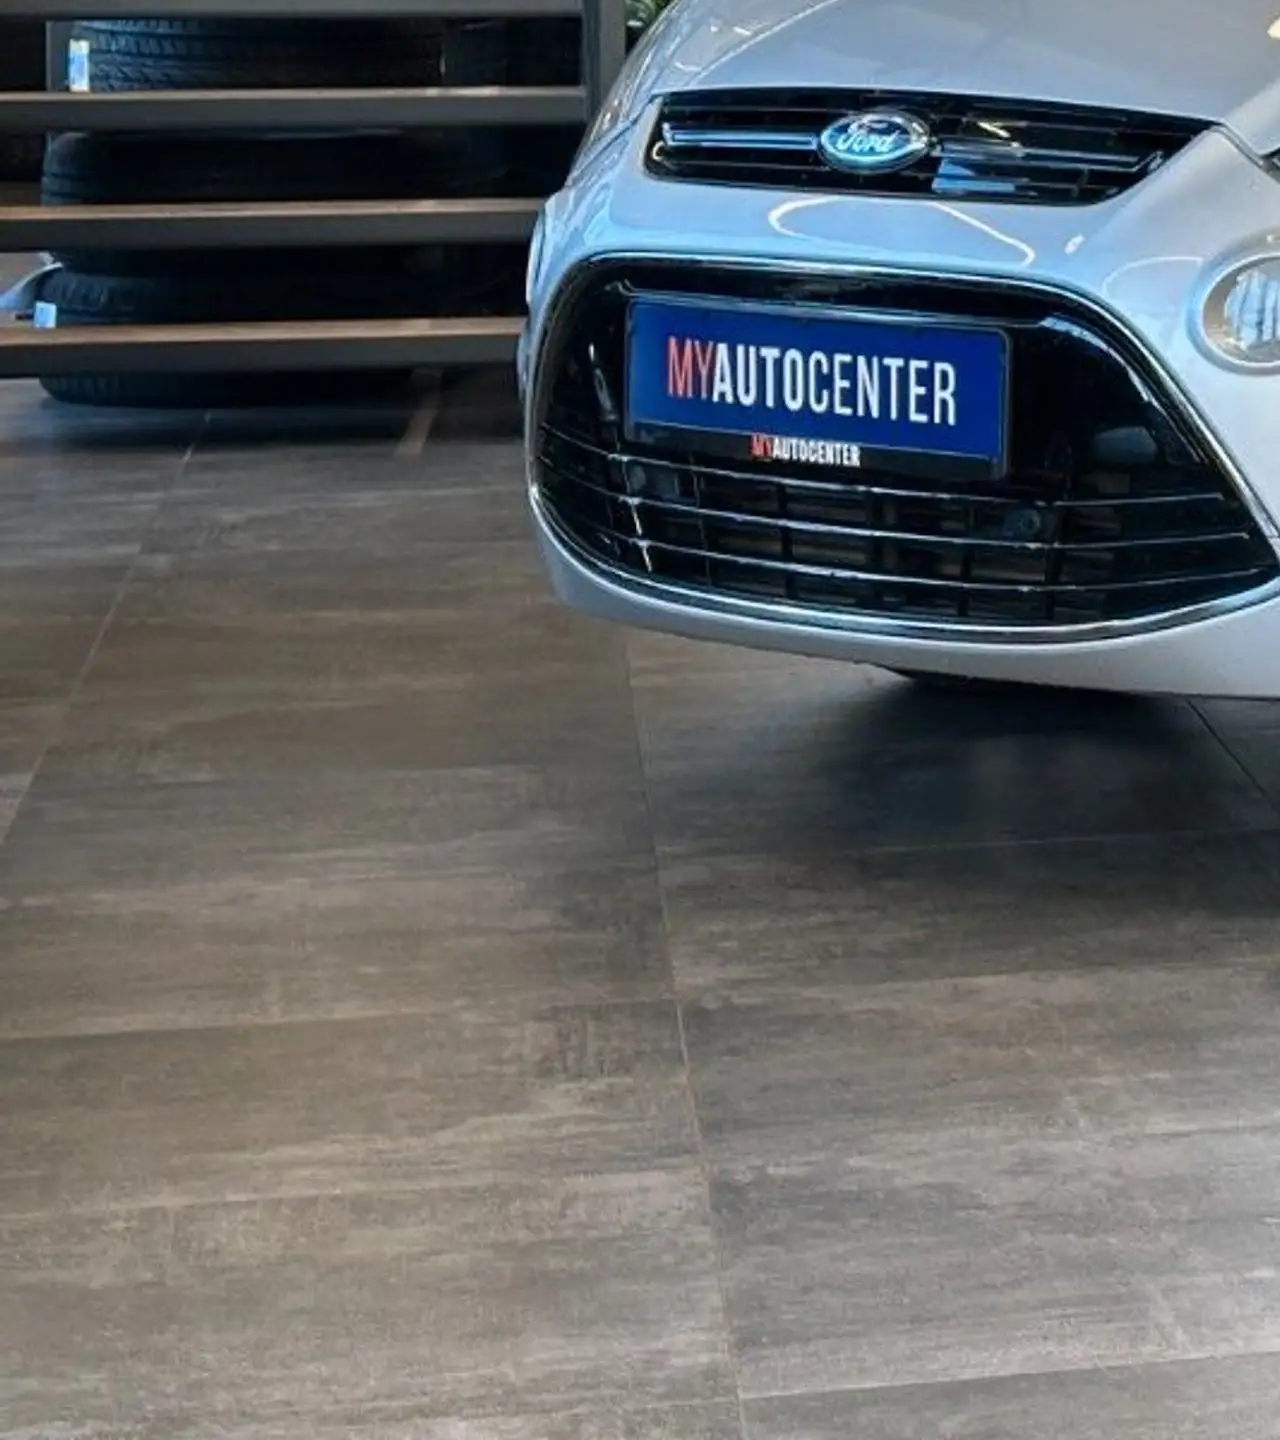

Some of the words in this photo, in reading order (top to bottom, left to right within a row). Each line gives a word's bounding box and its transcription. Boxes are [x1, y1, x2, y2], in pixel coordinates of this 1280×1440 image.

[836, 121, 901, 153] Ford
[666, 335, 957, 427] MYAUTOCENTER
[751, 432, 862, 468] MYAUTOCENTER
